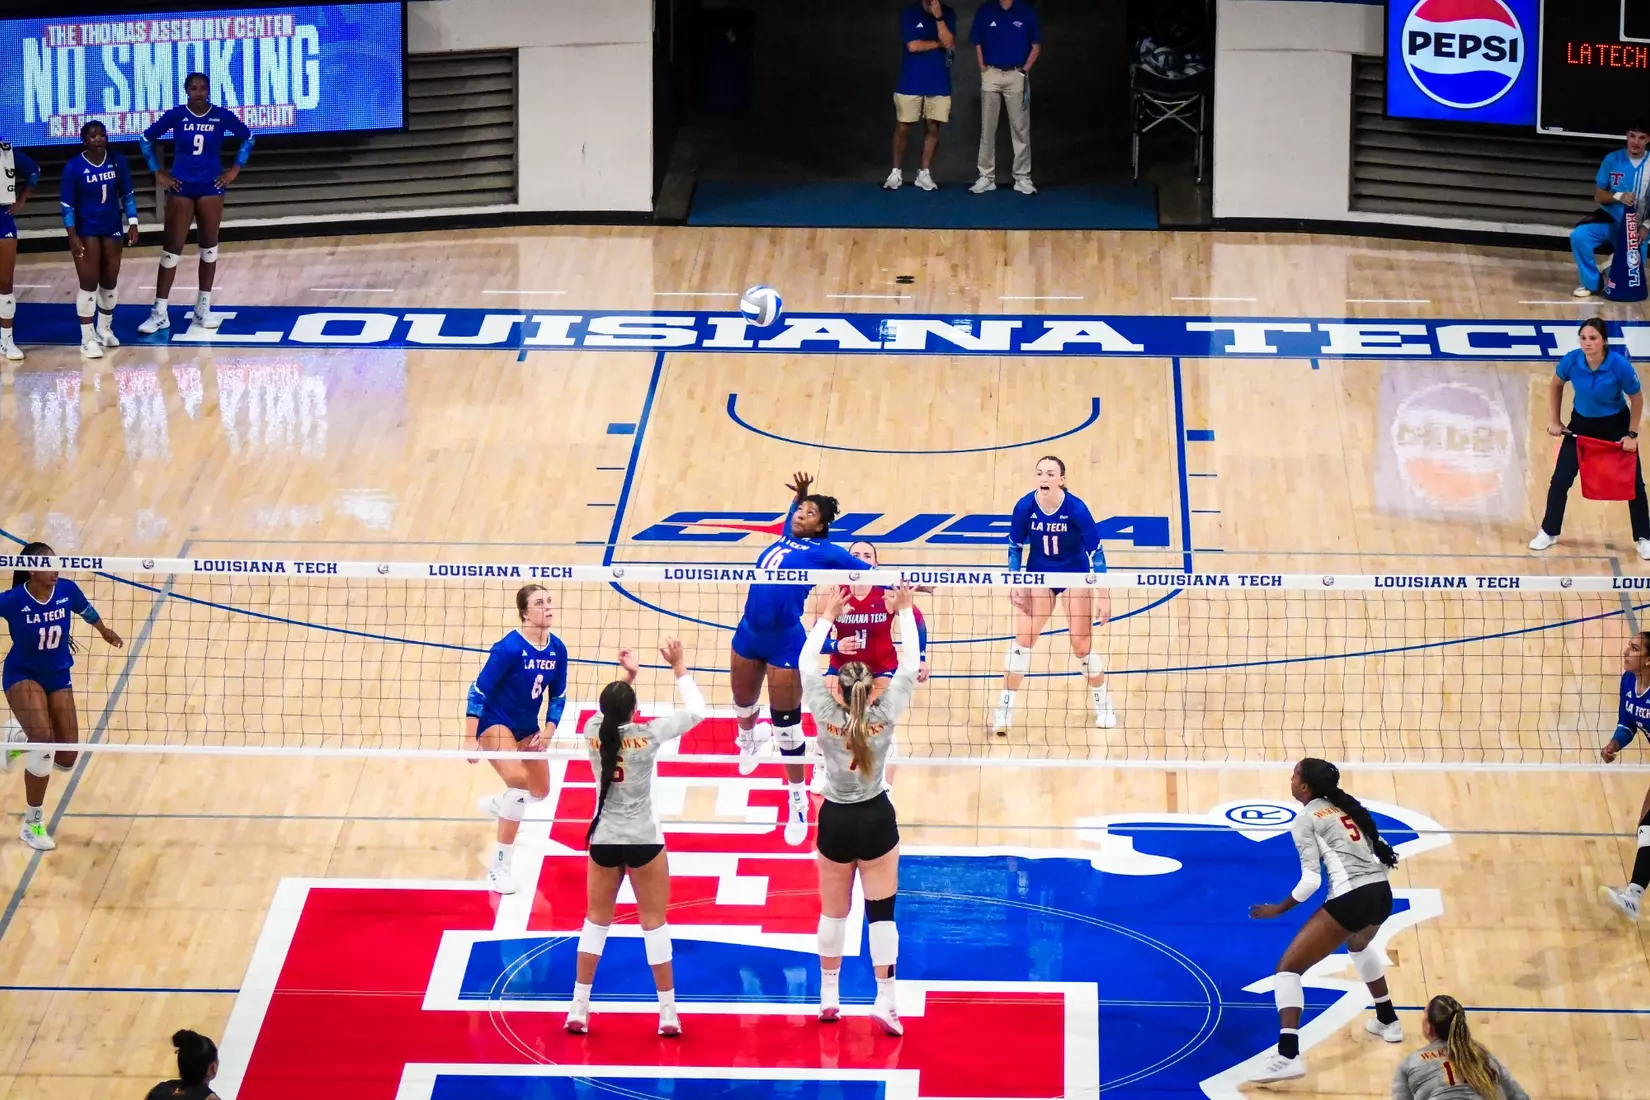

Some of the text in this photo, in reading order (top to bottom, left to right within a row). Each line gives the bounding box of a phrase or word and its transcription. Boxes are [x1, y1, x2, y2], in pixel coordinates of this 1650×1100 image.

[48, 14, 293, 46] THE THOMAS ASSEMBLY CENTER
[1408, 30, 1519, 63] PEPSI
[1567, 42, 1648, 69] LA TECH
[22, 24, 320, 123] NO SMOKING
[183, 123, 215, 132] LA TECH
[192, 134, 205, 156] 9
[86, 170, 116, 183] LA TECH
[1610, 172, 1624, 186] T
[100, 184, 107, 204] 1
[1626, 213, 1640, 287] LA TECH
[171, 311, 1650, 357] LOUISIANA TECH
[1031, 521, 1068, 532] LA TECH
[1042, 535, 1059, 556] 11
[59, 557, 103, 569] TECH
[760, 546, 792, 569] 16
[194, 560, 338, 574] LOUISIANA TECH
[428, 564, 573, 578] LOUISIANA TECH
[664, 568, 809, 582] LOUISIANA TECH
[900, 571, 1045, 585] LOUISIANA TECH
[1137, 574, 1283, 587] LOUISIANA TECH
[1374, 576, 1521, 589] LOUISIANA TECH
[26, 607, 66, 624] LA TECH
[871, 612, 887, 624] TECH
[38, 625, 62, 650] 10
[524, 658, 557, 670] LA TECH
[1625, 700, 1634, 715] LA
[1339, 814, 1361, 842] 5
